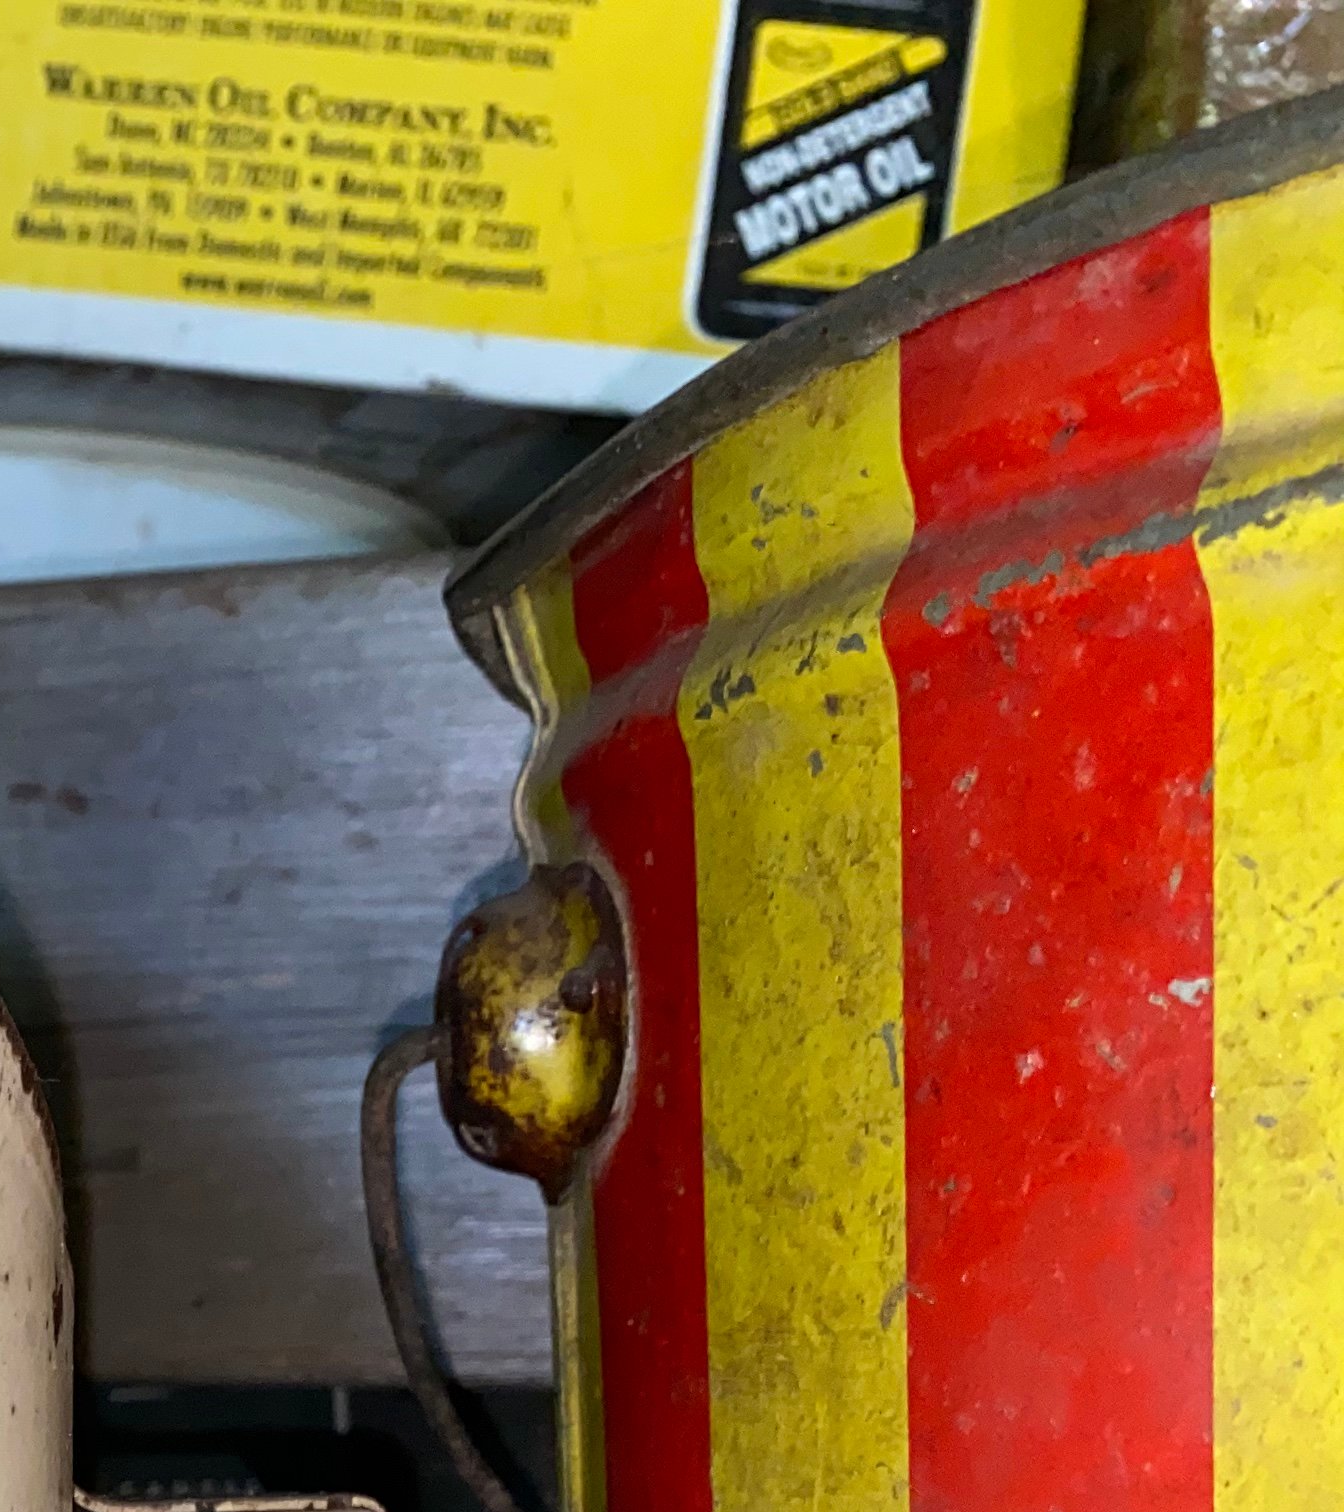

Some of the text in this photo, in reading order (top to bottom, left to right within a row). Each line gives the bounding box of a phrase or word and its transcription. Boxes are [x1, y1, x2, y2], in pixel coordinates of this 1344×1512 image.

[43, 62, 200, 108] WARREN
[206, 77, 278, 121] OIL
[733, 134, 937, 261] MOTOR OIL
